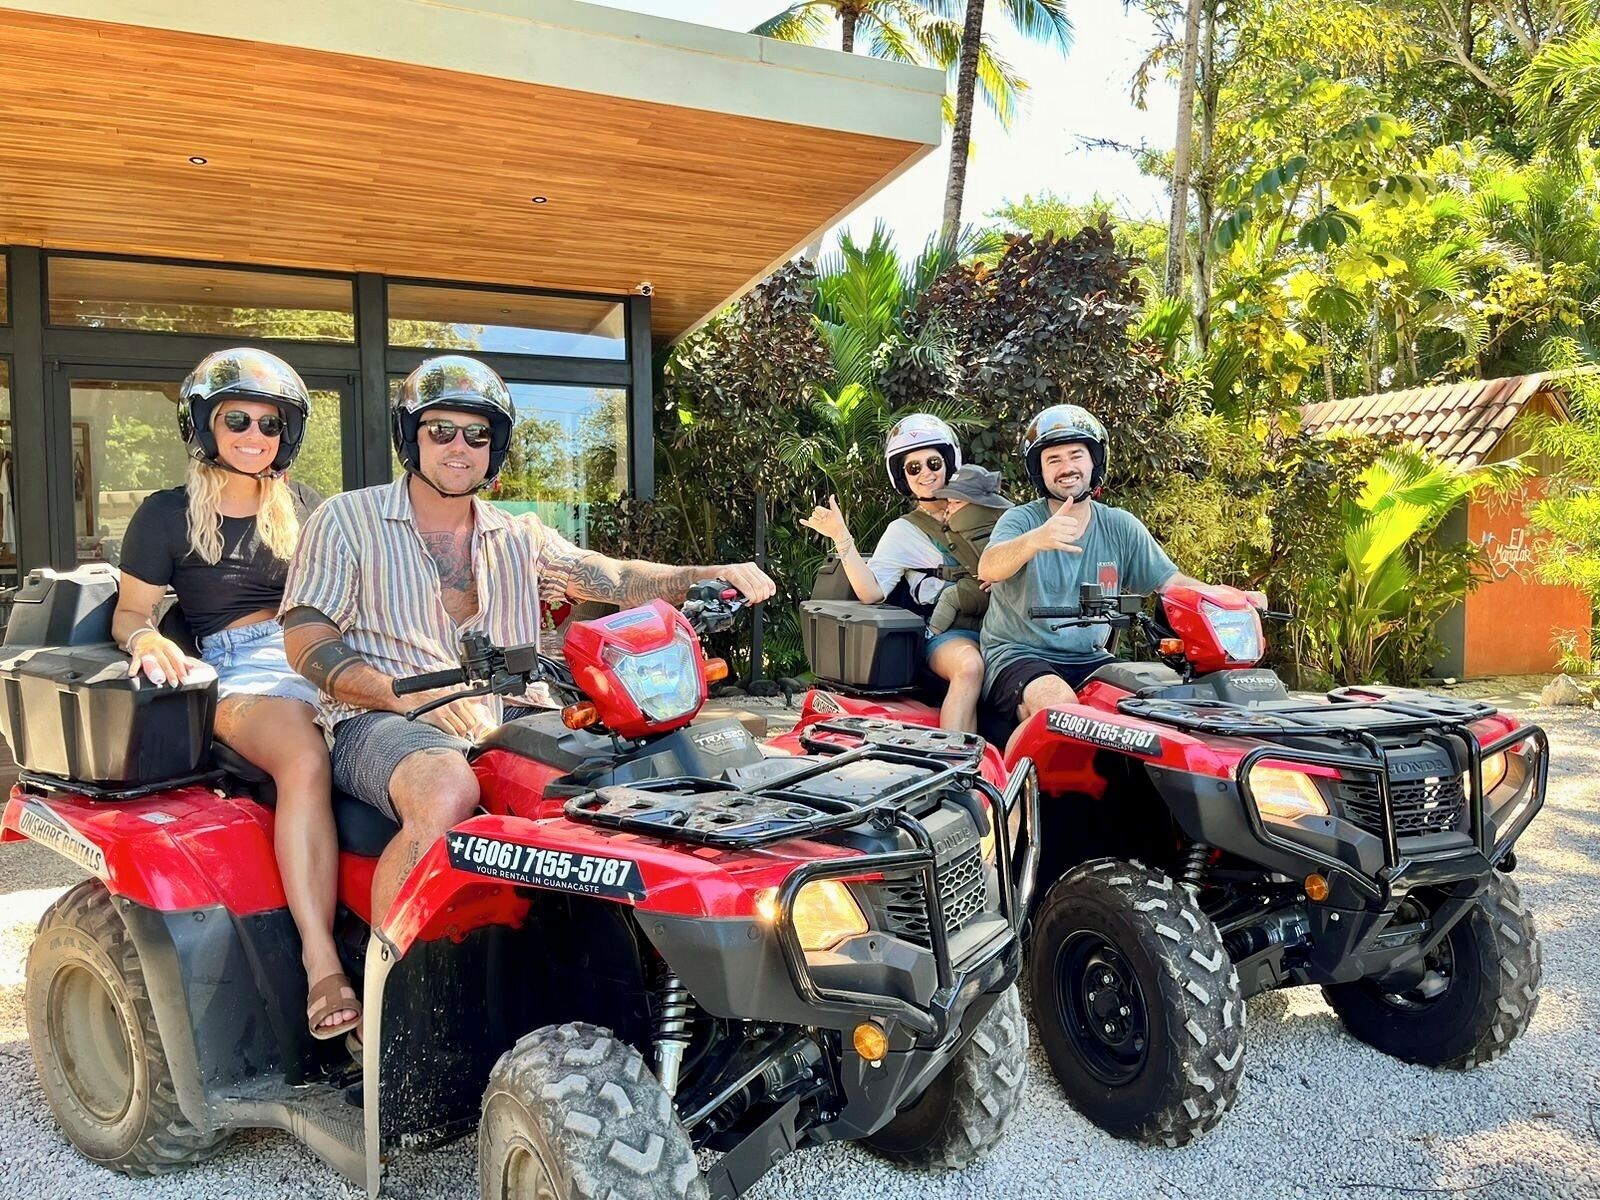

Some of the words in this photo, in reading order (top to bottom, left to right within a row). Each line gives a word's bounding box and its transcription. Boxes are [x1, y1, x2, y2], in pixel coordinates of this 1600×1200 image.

[694, 730, 745, 746] TRX520
[21, 812, 62, 848] ONSHORE
[62, 834, 101, 871] RENTALS
[476, 865, 498, 876] YOUR
[499, 869, 530, 883] RENTAL
[532, 876, 541, 885] IN
[543, 878, 600, 893] GUANACASTE
[523, 847, 632, 887] 7155-5787
